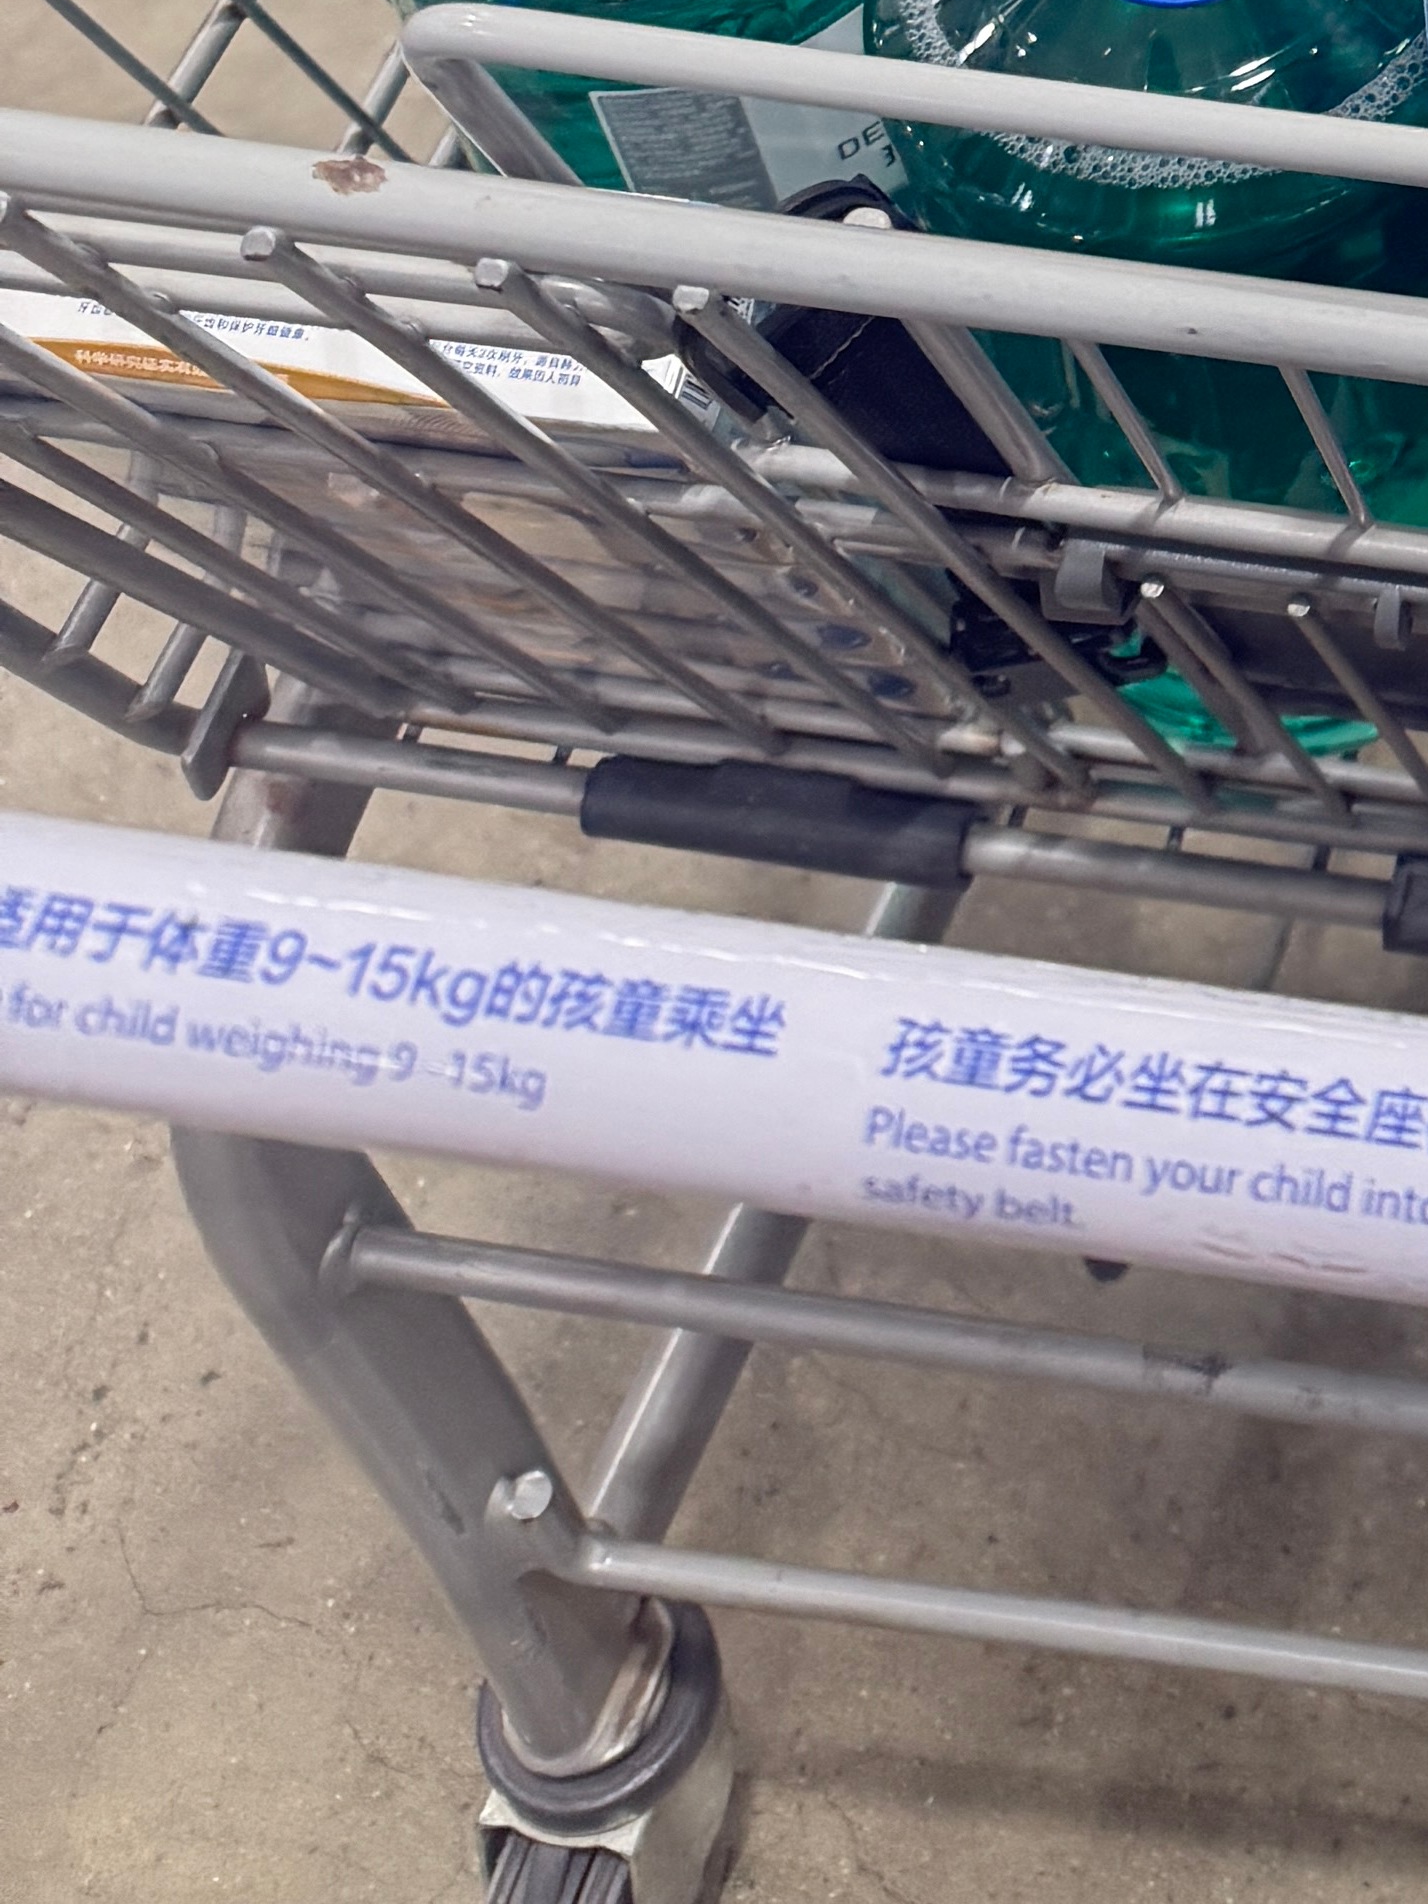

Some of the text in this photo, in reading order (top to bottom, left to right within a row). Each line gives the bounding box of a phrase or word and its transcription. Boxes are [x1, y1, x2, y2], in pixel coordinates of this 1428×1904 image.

[73, 990, 177, 1047] child
[186, 1017, 383, 1089] weighing
[858, 1172, 987, 1224] safety
[862, 1104, 1000, 1168] Please
[1004, 1122, 1135, 1187] fasten
[1139, 1144, 1243, 1205] your
[1248, 1159, 1354, 1216] child
